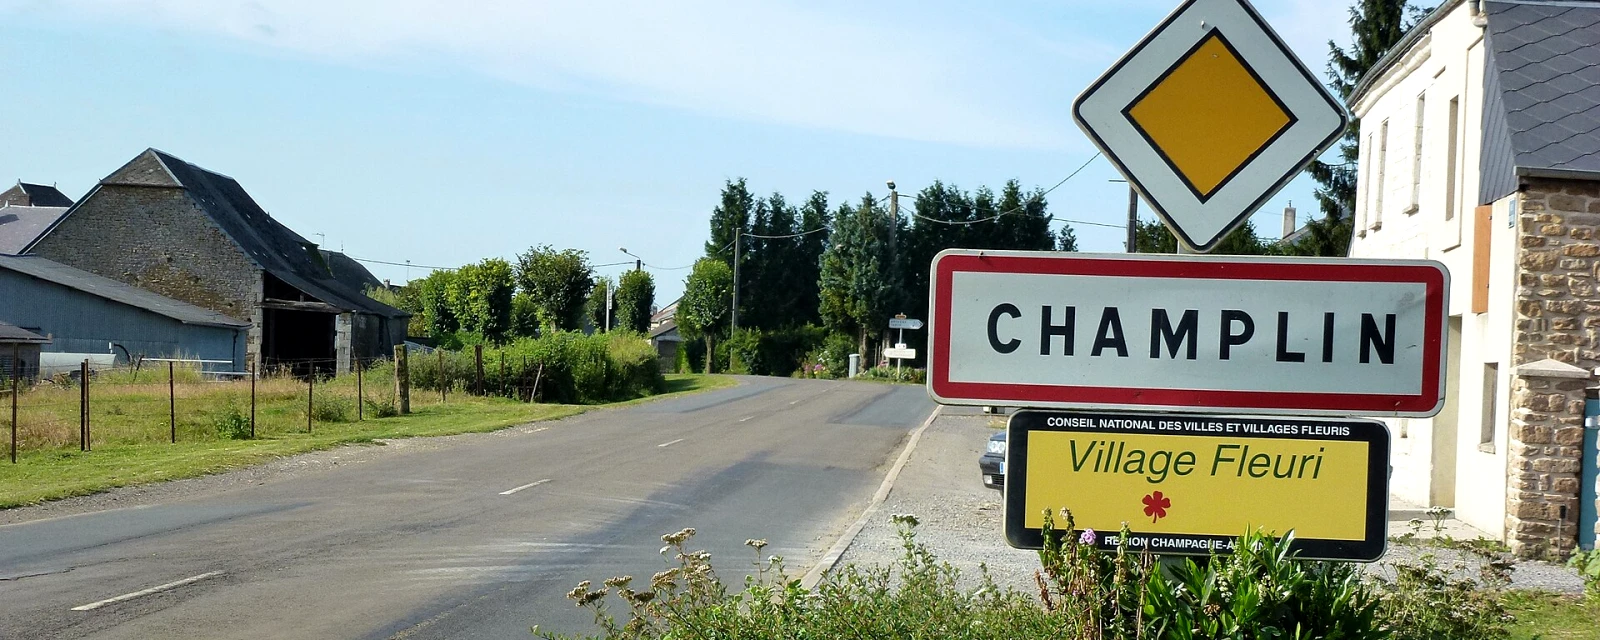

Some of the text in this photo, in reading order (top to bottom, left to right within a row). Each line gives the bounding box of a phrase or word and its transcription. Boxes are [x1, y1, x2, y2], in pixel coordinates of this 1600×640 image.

[987, 302, 1397, 364] CHAMPLIN
[1047, 417, 1350, 436] CONSEIL NATIONAL DES VILLES ET VILLAGES FLEURIS
[1069, 440, 1325, 483] Village Fleuri
